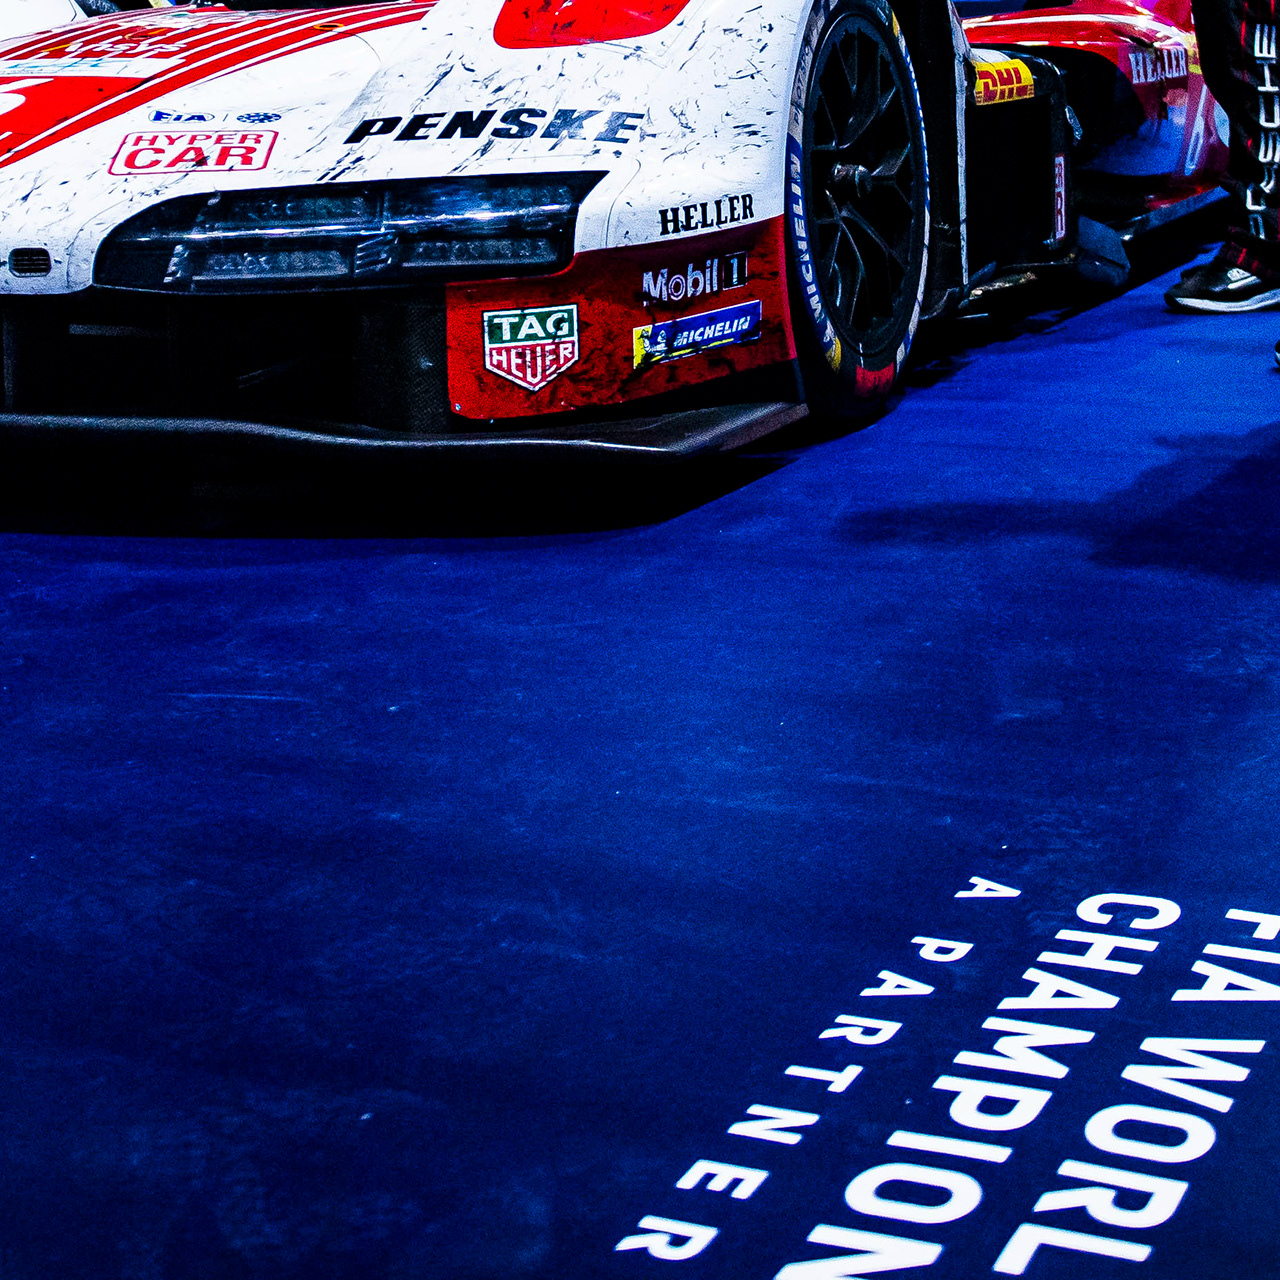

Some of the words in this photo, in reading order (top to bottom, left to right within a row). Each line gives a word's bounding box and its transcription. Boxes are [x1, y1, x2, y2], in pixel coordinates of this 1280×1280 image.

[977, 66, 1030, 102] DHL
[152, 110, 208, 122] FIA
[342, 108, 646, 145] PENSKE
[124, 146, 258, 169] CAR
[131, 133, 264, 146] HYPER
[658, 193, 755, 236] HELLER
[787, 152, 824, 324] MICHELIN
[642, 258, 719, 304] Mobil
[493, 312, 570, 341] TAG
[673, 315, 751, 348] MICHELIN
[491, 342, 573, 385] HEUER
[953, 875, 1023, 899] A
[613, 935, 975, 1262] PARTNER
